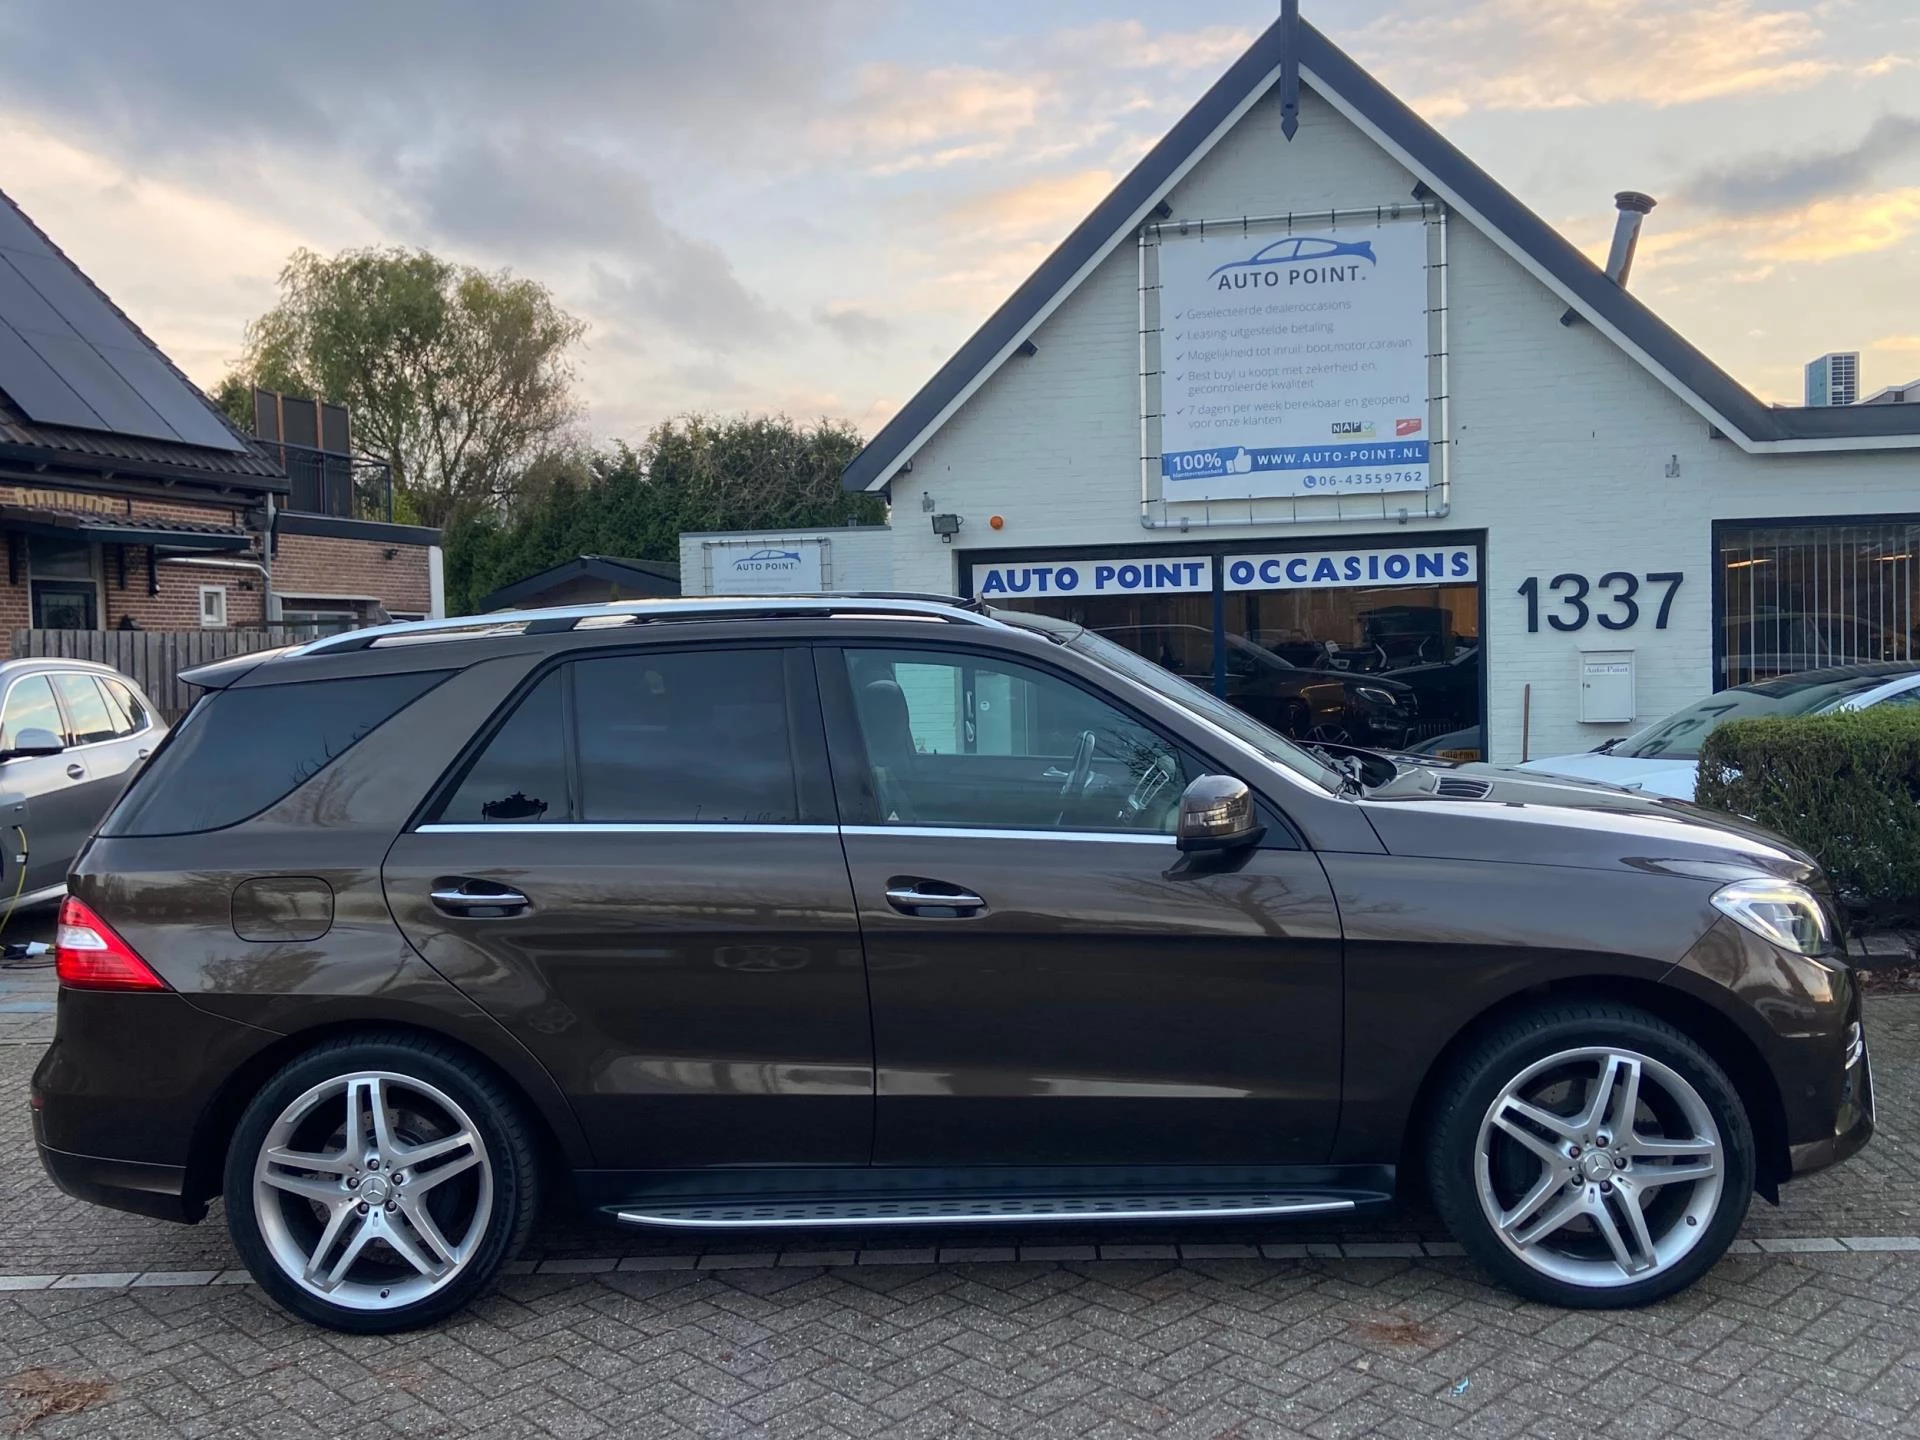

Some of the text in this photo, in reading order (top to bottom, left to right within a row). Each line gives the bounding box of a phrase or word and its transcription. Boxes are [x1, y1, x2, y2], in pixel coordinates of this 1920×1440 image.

[1218, 271, 1279, 290] AUTO
[1186, 300, 1352, 320] Geselecteerde dealeroccasions
[1187, 321, 1334, 341] Leasing uitgestelde betaling
[1187, 345, 1254, 363] Mogelijkheid
[1255, 346, 1271, 357] tot
[1187, 370, 1211, 382] Best
[1238, 370, 1246, 378] u
[1248, 366, 1279, 379] koopt
[1281, 363, 1303, 376] met
[1305, 360, 1359, 375] zekerheid
[1187, 377, 1315, 398] gecontroleerde kwaliteit
[1188, 393, 1411, 417] 7 dagen per week bereikbaar en geopend
[1187, 414, 1283, 430] voor onze klanten
[1331, 421, 1362, 434] NAP
[1172, 451, 1222, 472] 100%
[1257, 447, 1422, 465] WWW.AUTO-POINT.NL
[1318, 471, 1423, 488] 06-43559762
[736, 562, 762, 571] AUTO
[1229, 551, 1469, 585] OCCASIONS
[982, 562, 1205, 593] AUTO POINT
[1516, 571, 1685, 633] 1337
